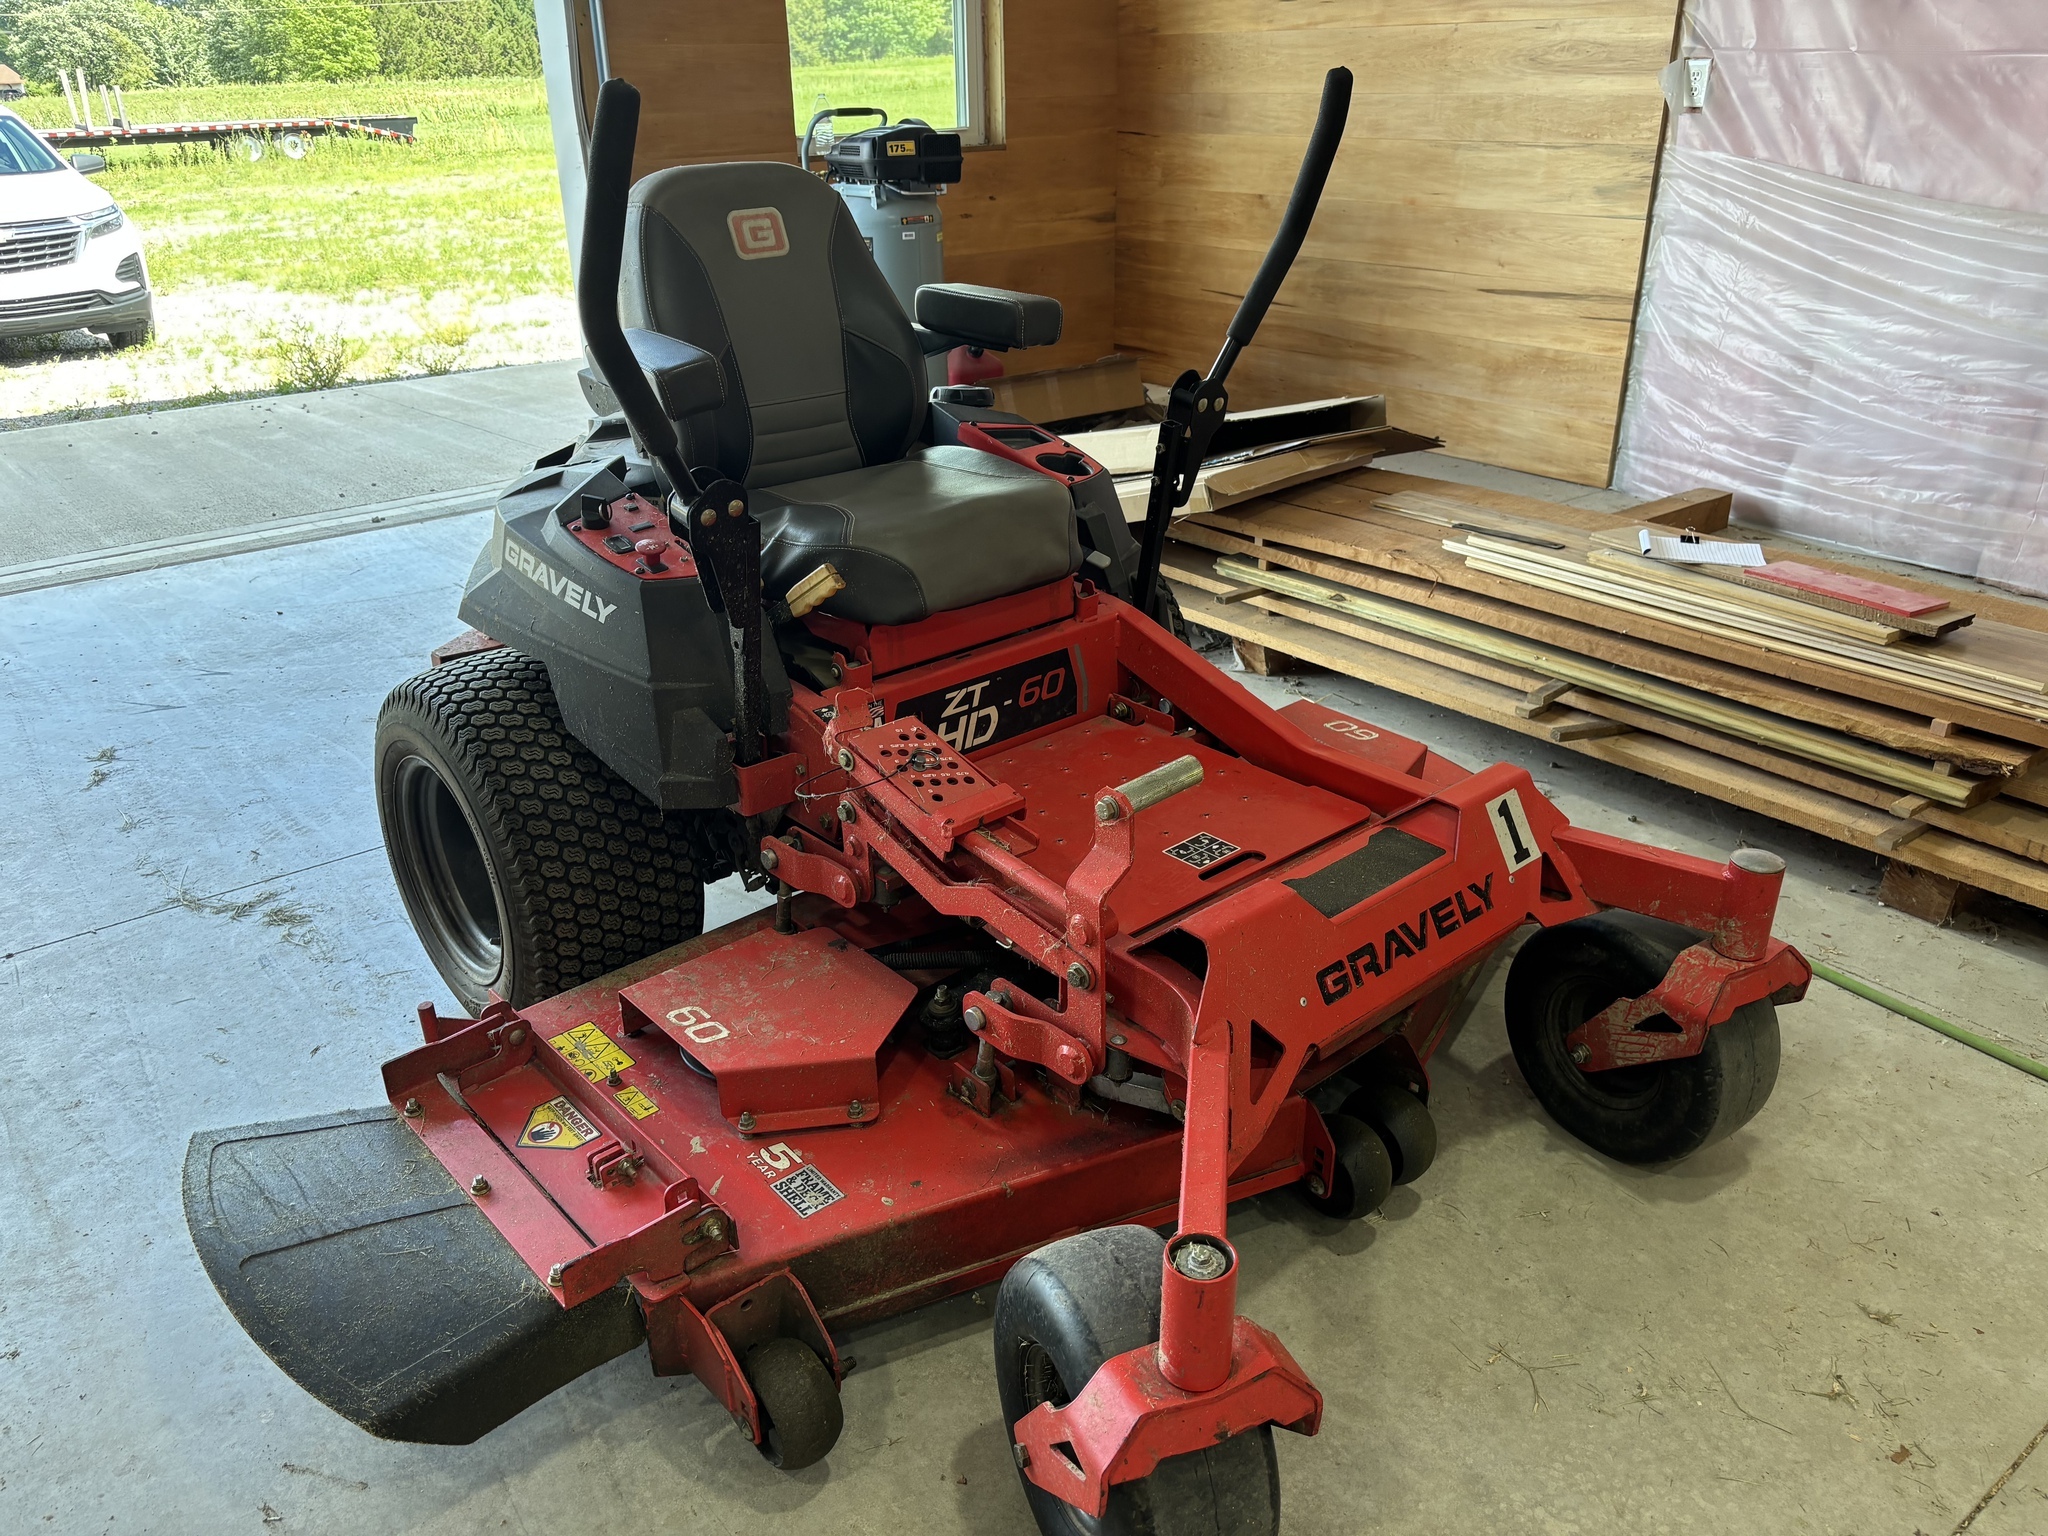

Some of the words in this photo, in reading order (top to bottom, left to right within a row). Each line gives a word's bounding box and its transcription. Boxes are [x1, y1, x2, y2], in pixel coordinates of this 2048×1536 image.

[889, 144, 906, 153] 175
[505, 539, 618, 624] GRAVELY
[941, 680, 991, 718] ZT
[937, 705, 999, 752] HD
[1323, 720, 1379, 740] 60
[1497, 799, 1532, 864] 1
[1316, 872, 1494, 1006] GRAVELY
[666, 1006, 731, 1044] 60
[554, 1100, 594, 1138] DANGER
[566, 1125, 576, 1134] FEET
[746, 1152, 777, 1178] YEAR
[760, 1142, 804, 1170] 5
[773, 1181, 812, 1216] SHELL
[786, 1174, 797, 1185] &
[794, 1182, 824, 1210] DECK
[796, 1170, 835, 1204] FRAME
[806, 1166, 822, 1181] LIMITED
[820, 1178, 841, 1198] WARRANTY
